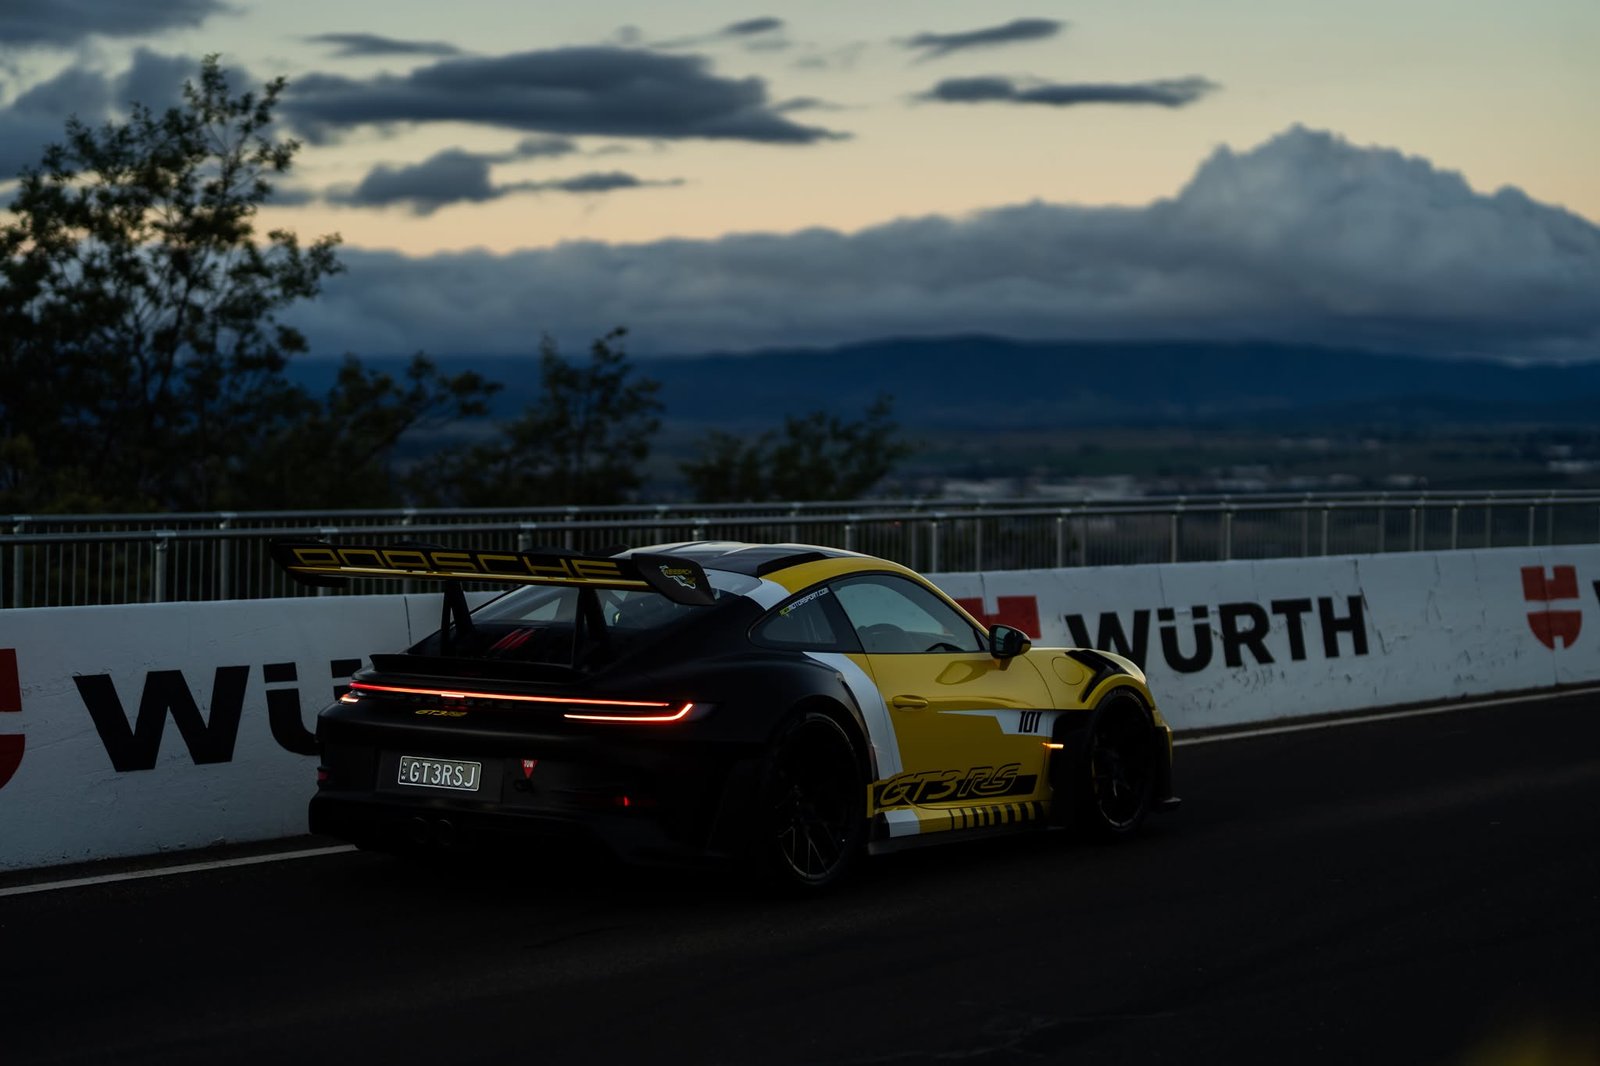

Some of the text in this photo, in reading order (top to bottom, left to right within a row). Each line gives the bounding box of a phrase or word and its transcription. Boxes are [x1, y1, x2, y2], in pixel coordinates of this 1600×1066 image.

[291, 547, 622, 580] PORSCHE
[1066, 595, 1369, 673] WÜRTH
[72, 659, 362, 773] WÜ
[1018, 711, 1043, 733] 101
[400, 761, 408, 780] NSW
[409, 761, 476, 787] GT3RSJ
